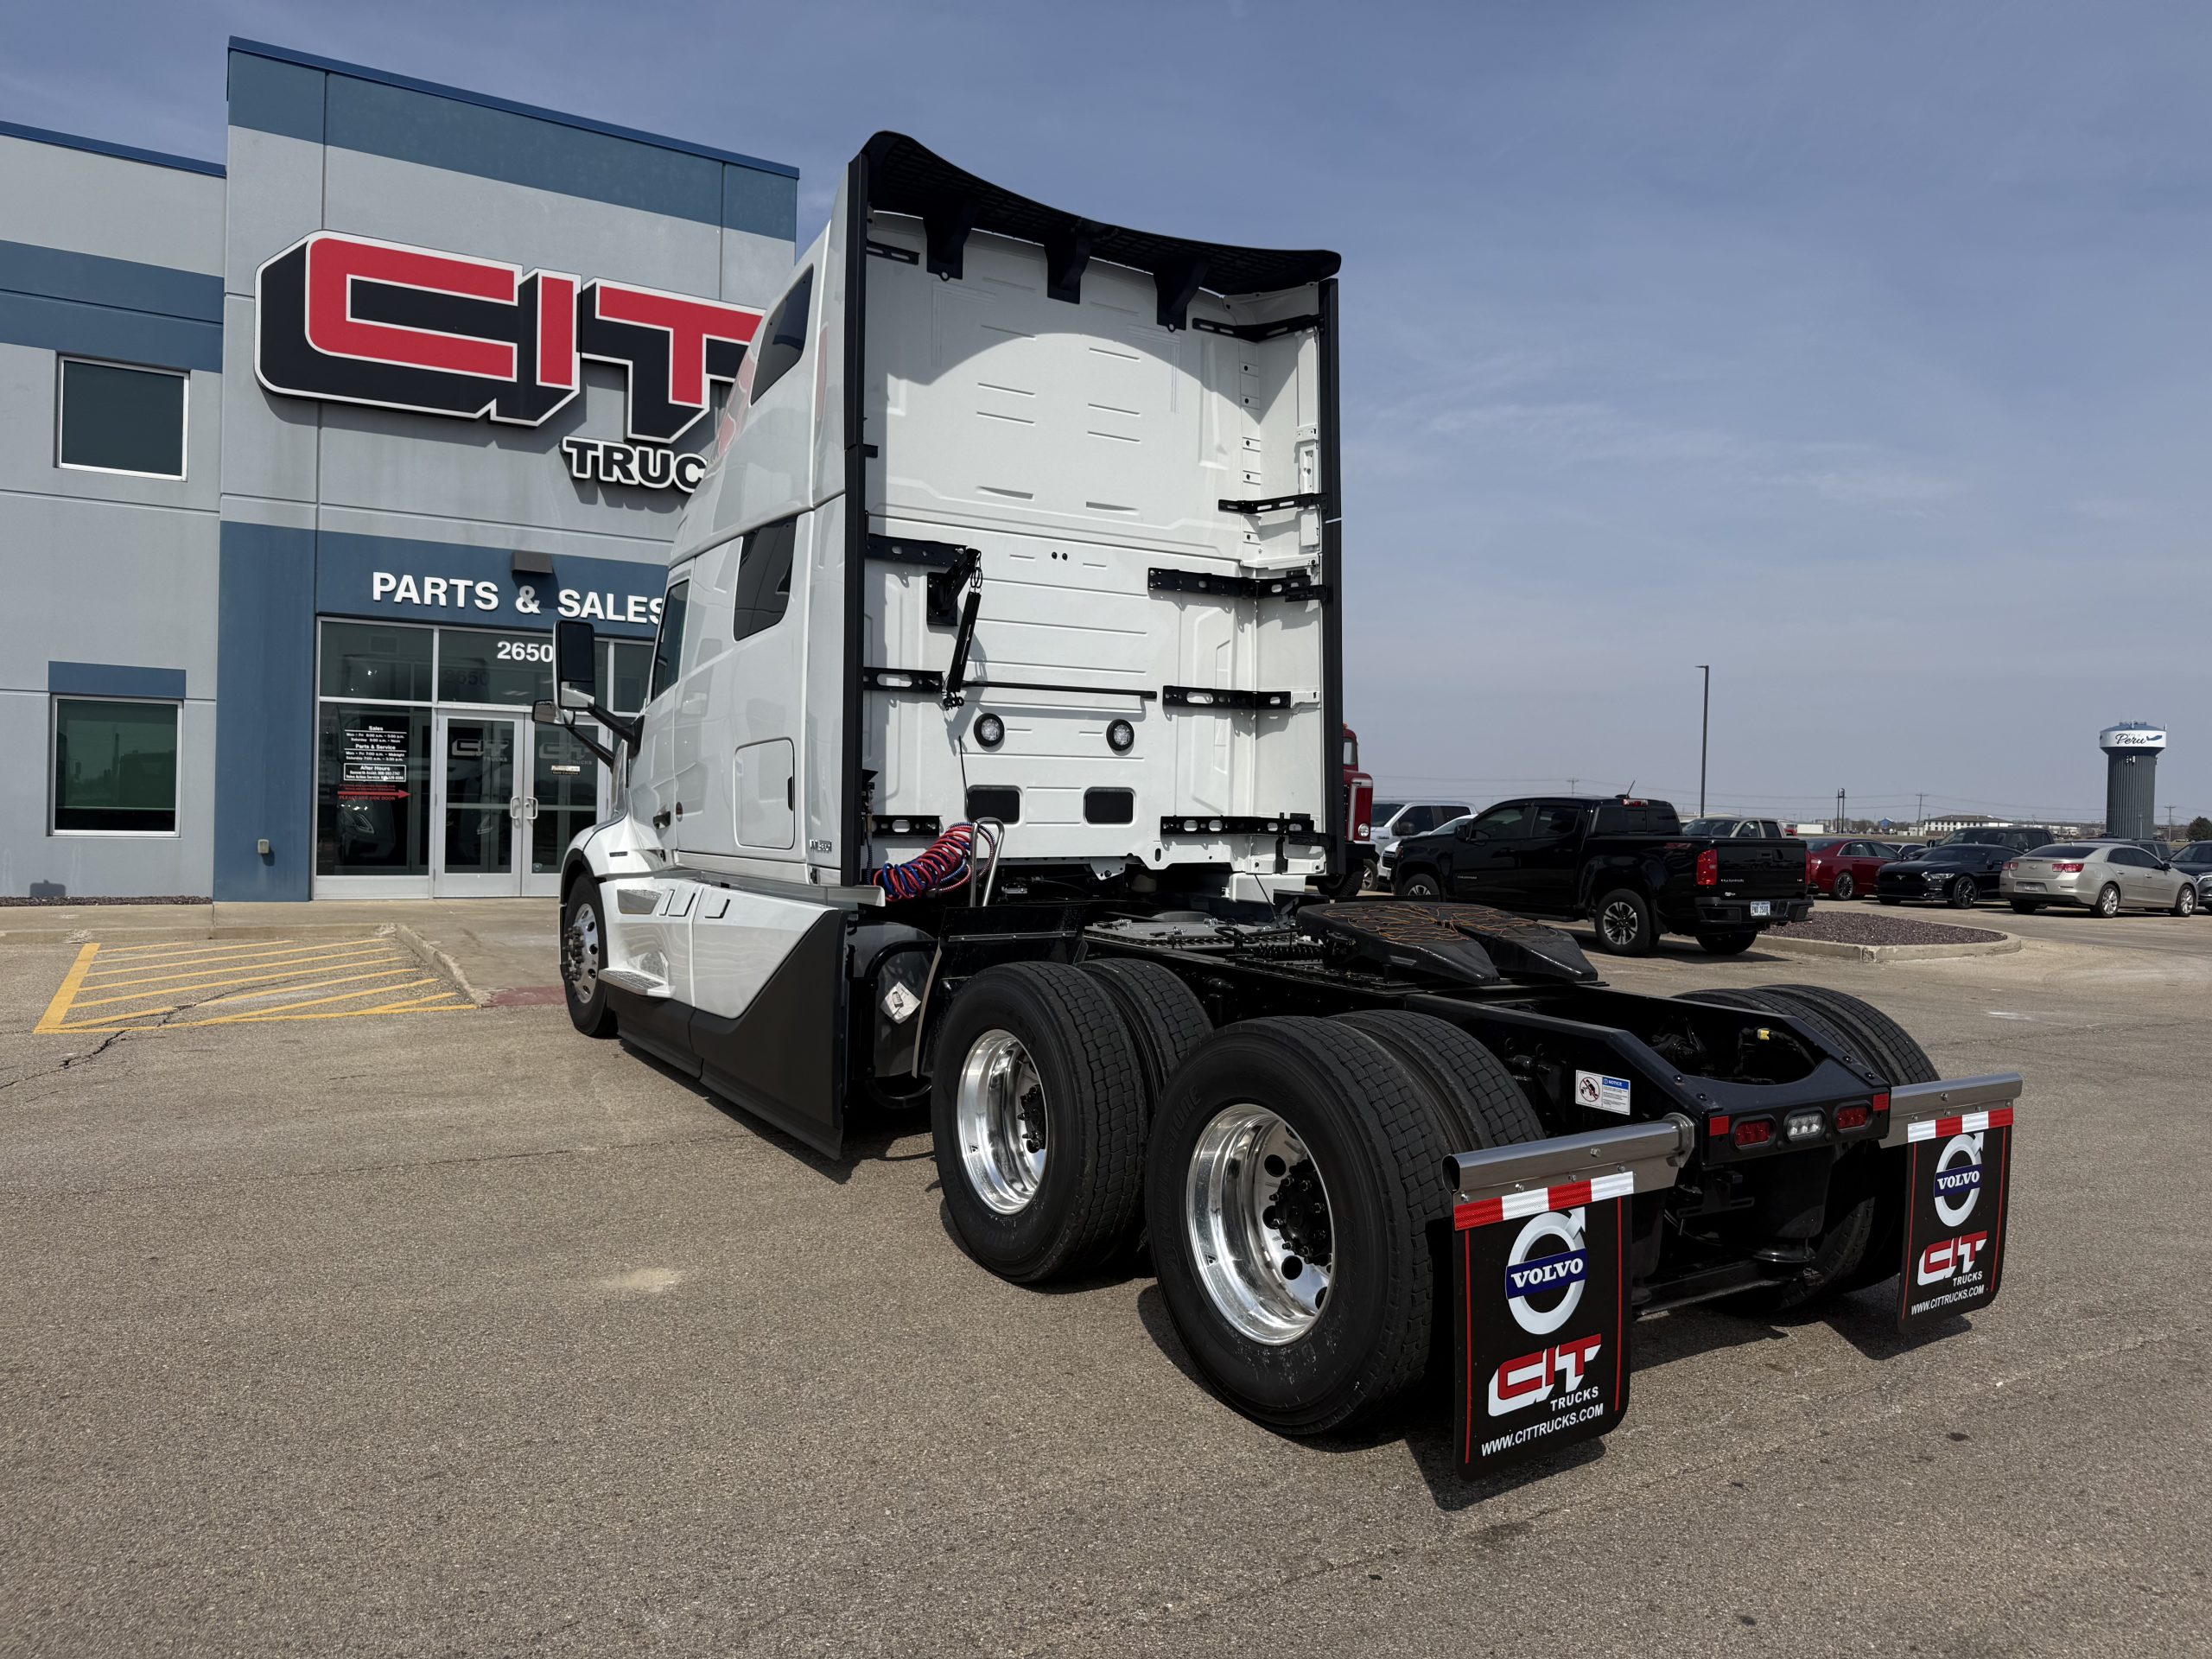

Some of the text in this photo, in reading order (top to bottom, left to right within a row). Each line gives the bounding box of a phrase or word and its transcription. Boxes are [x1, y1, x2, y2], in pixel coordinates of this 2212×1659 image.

[257, 231, 766, 442] CIT
[562, 435, 708, 493] TRUC
[372, 571, 499, 611] PARTS
[515, 584, 541, 614] &
[497, 640, 553, 663] 2650
[452, 739, 510, 757] CIT
[2115, 733, 2146, 745] Peru
[1937, 1170, 1980, 1190] VOLVO
[1510, 1258, 1584, 1288] VOLVO
[1917, 1230, 1987, 1286] CIT
[1953, 1270, 1983, 1287] TRUCKS
[1910, 1284, 1985, 1315] WWW.CITTRUCKS.COM
[1488, 1333, 1601, 1416] CIT
[1550, 1386, 1599, 1412] TRUCKS
[1481, 1403, 1604, 1457] WWW.CITTRUCKS.COM
